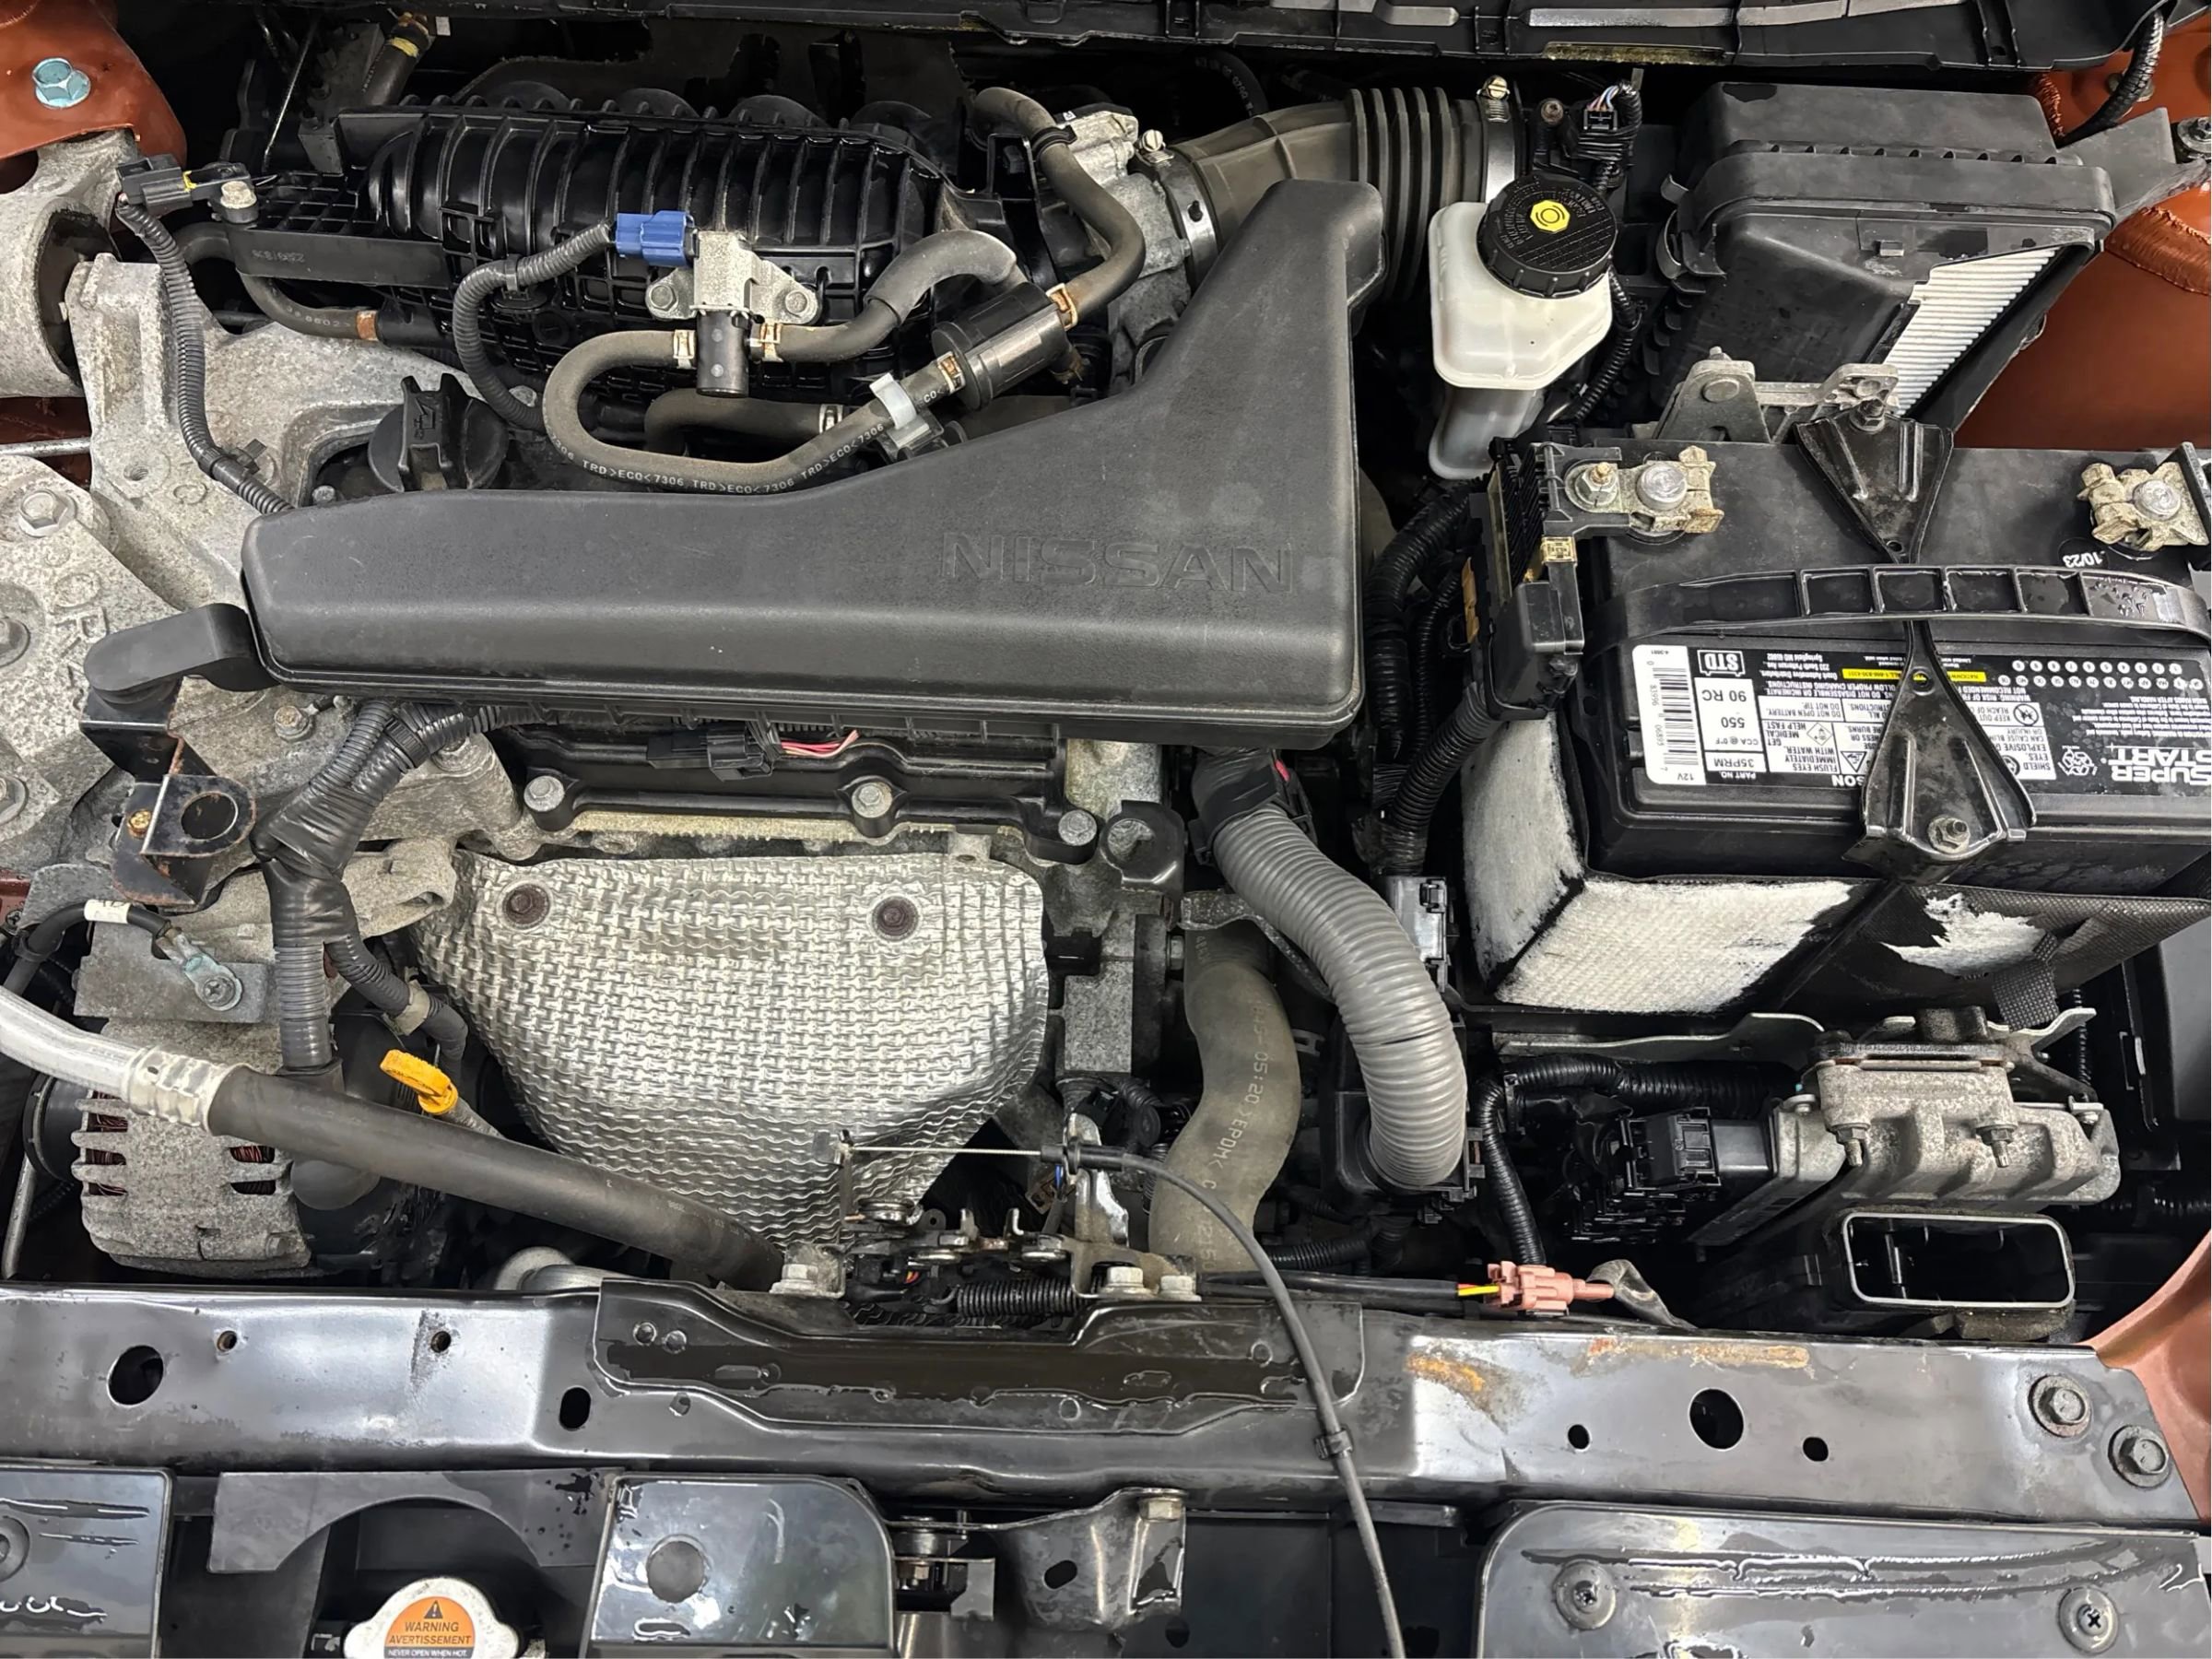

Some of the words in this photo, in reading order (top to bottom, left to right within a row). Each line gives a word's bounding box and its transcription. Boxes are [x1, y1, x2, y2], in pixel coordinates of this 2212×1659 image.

[941, 532, 1292, 593] NISSAN
[1704, 653, 1740, 671] STD
[1873, 683, 1896, 691] OLLOW
[1701, 689, 1724, 701] RC
[1729, 690, 1747, 702] 90
[1766, 708, 1796, 716] BATTERY.
[1847, 703, 1889, 712] STRUCTIONS.
[1721, 717, 1745, 729] 550
[1764, 721, 1786, 729] FAST.
[1787, 722, 1806, 731] HELP
[1766, 730, 1799, 738] MEDICAL
[1844, 725, 1870, 734] BURNS.
[1768, 738, 1782, 747] GET
[1783, 746, 1813, 754] WATER.
[1815, 747, 1834, 755] WITH
[2004, 743, 2046, 752] EXPLOSIVE
[1784, 755, 1836, 764] IMMEDIATELY
[2026, 752, 2048, 761] EYES.
[2108, 748, 2211, 766] START
[1713, 758, 1755, 768] 35PRM
[1793, 763, 1812, 771] EYES
[1814, 763, 1838, 772] FLUSH
[2023, 761, 2051, 771] SHIELD
[1677, 772, 1694, 781] 12V
[1720, 771, 1733, 779] NO.
[1735, 771, 1756, 780] PART
[2111, 765, 2211, 786] SUPER
[1831, 774, 1865, 787] SON
[405, 1621, 459, 1632] WARNING
[388, 1635, 472, 1644] AVERTISSEMENT
[388, 1649, 410, 1657] NEVER
[411, 1649, 429, 1657] OPEN
[430, 1649, 453, 1657] WHEN
